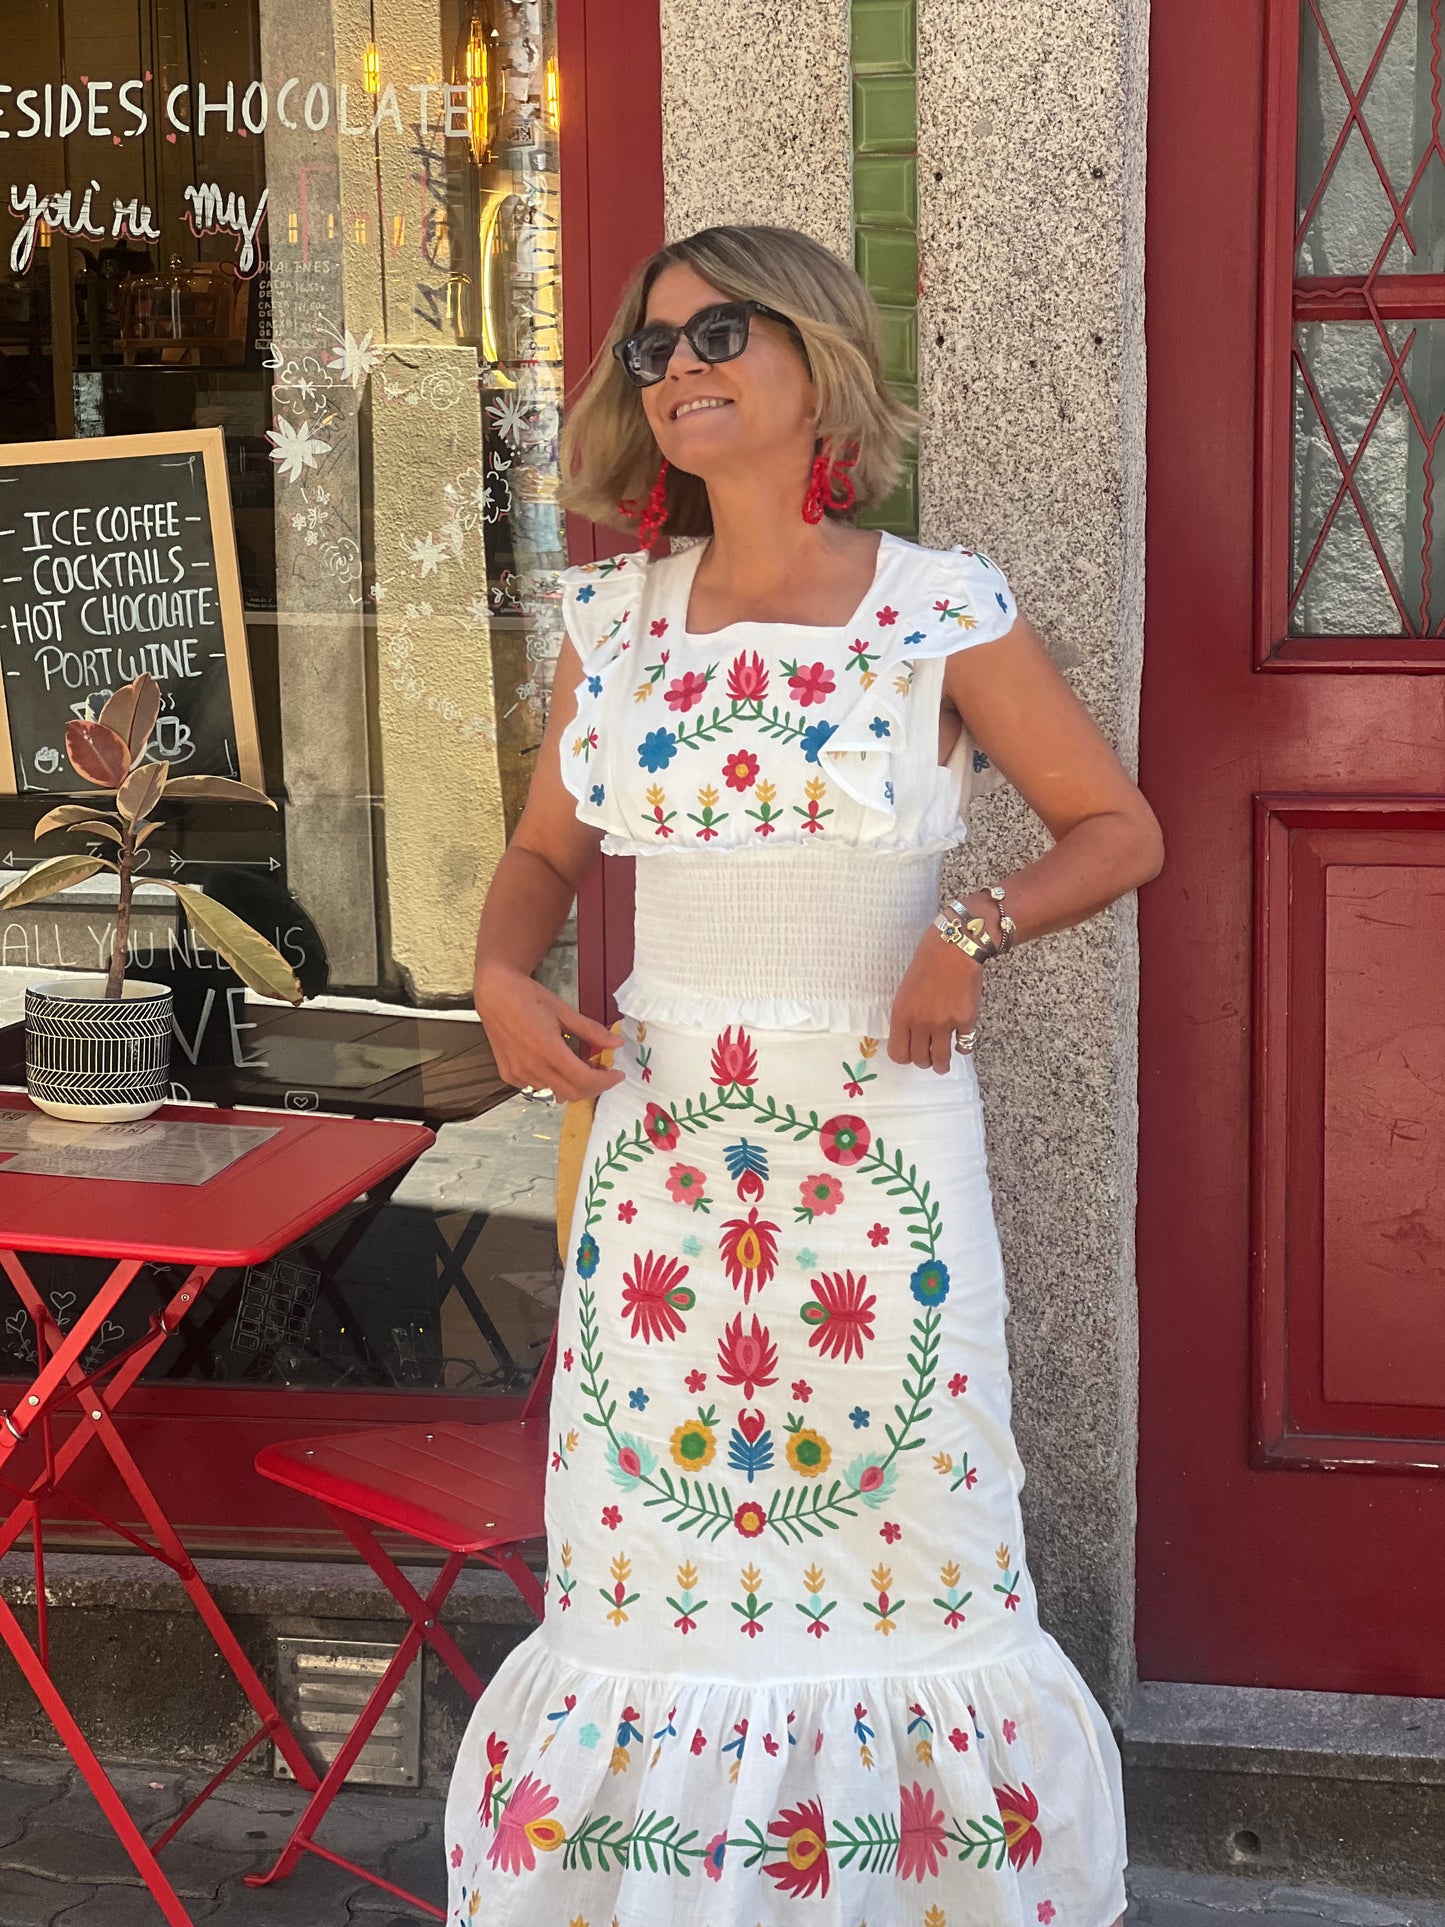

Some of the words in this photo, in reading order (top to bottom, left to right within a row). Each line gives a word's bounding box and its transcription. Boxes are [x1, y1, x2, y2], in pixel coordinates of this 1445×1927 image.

[166, 77, 472, 138] CHOCOLATE
[184, 182, 270, 272] my
[33, 545, 185, 596] COCKTAILS
[10, 600, 67, 646] HOT
[80, 587, 216, 636] CHOCOLATE
[3, 923, 77, 967] ALL
[87, 922, 154, 970] YOU
[167, 927, 232, 971] NE
[275, 926, 306, 969] IS
